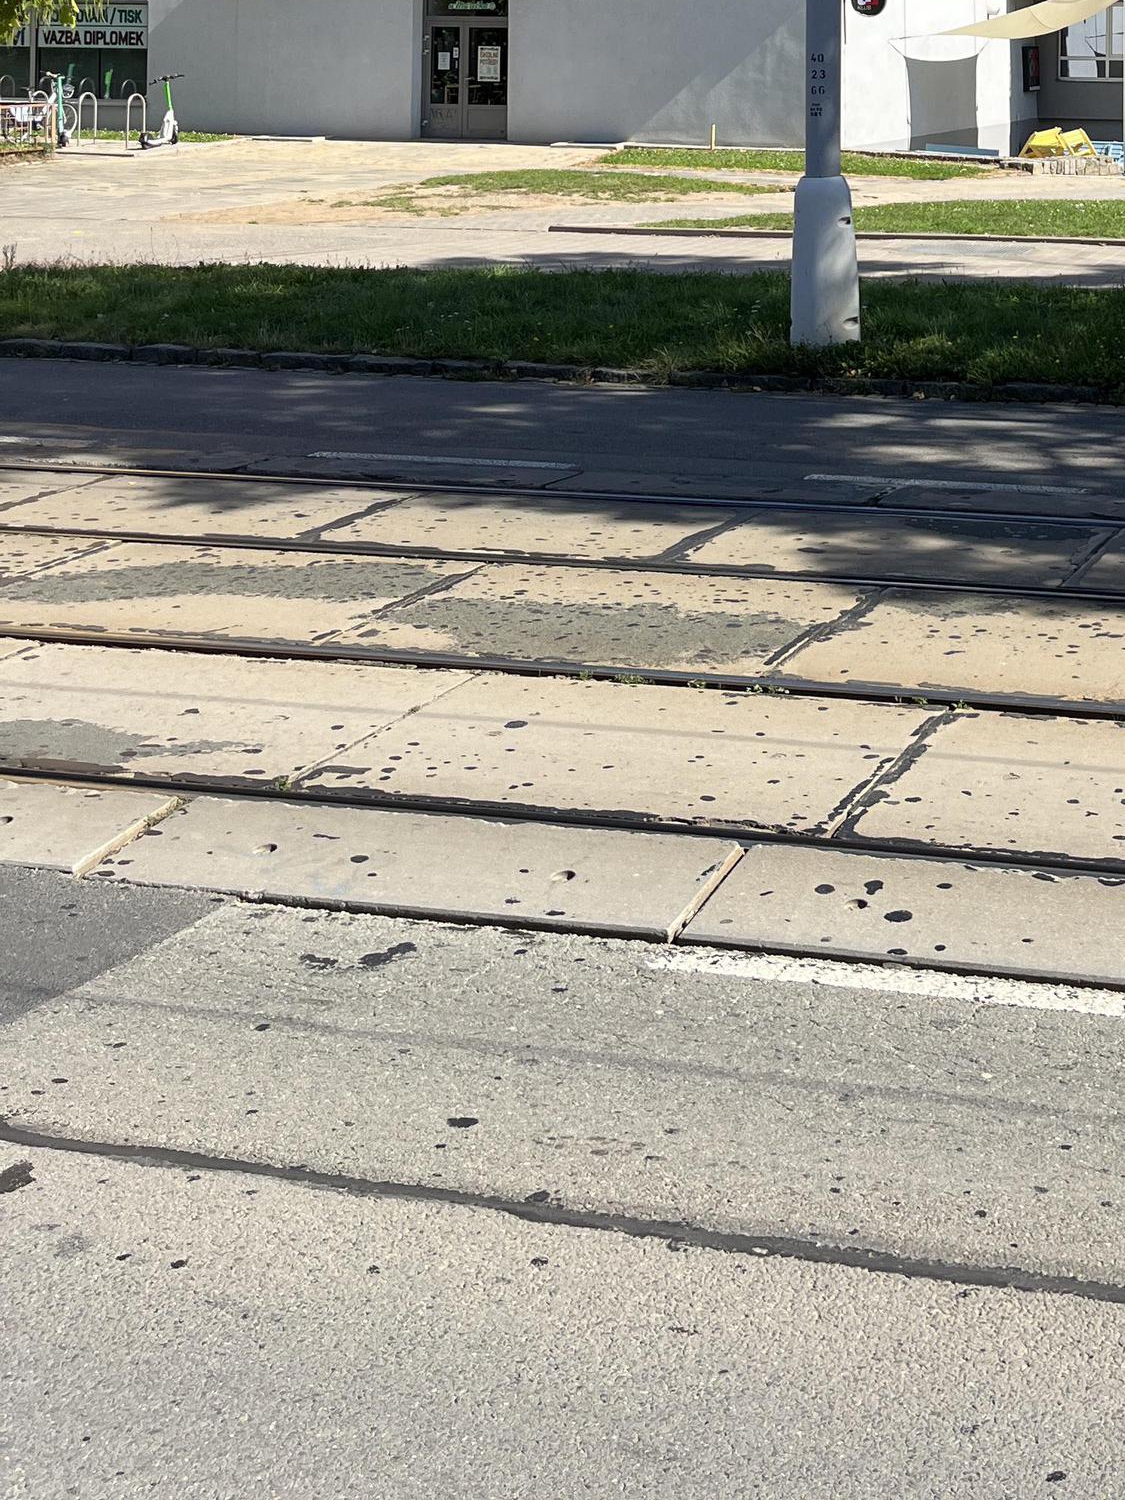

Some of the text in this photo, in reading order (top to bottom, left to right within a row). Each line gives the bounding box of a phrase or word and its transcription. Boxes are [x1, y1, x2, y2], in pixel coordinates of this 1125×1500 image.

[117, 9, 143, 24] TISK
[43, 30, 81, 45] VAZBA
[84, 30, 144, 46] DIPLOMEK
[810, 52, 825, 64] 40
[811, 69, 827, 80] 23
